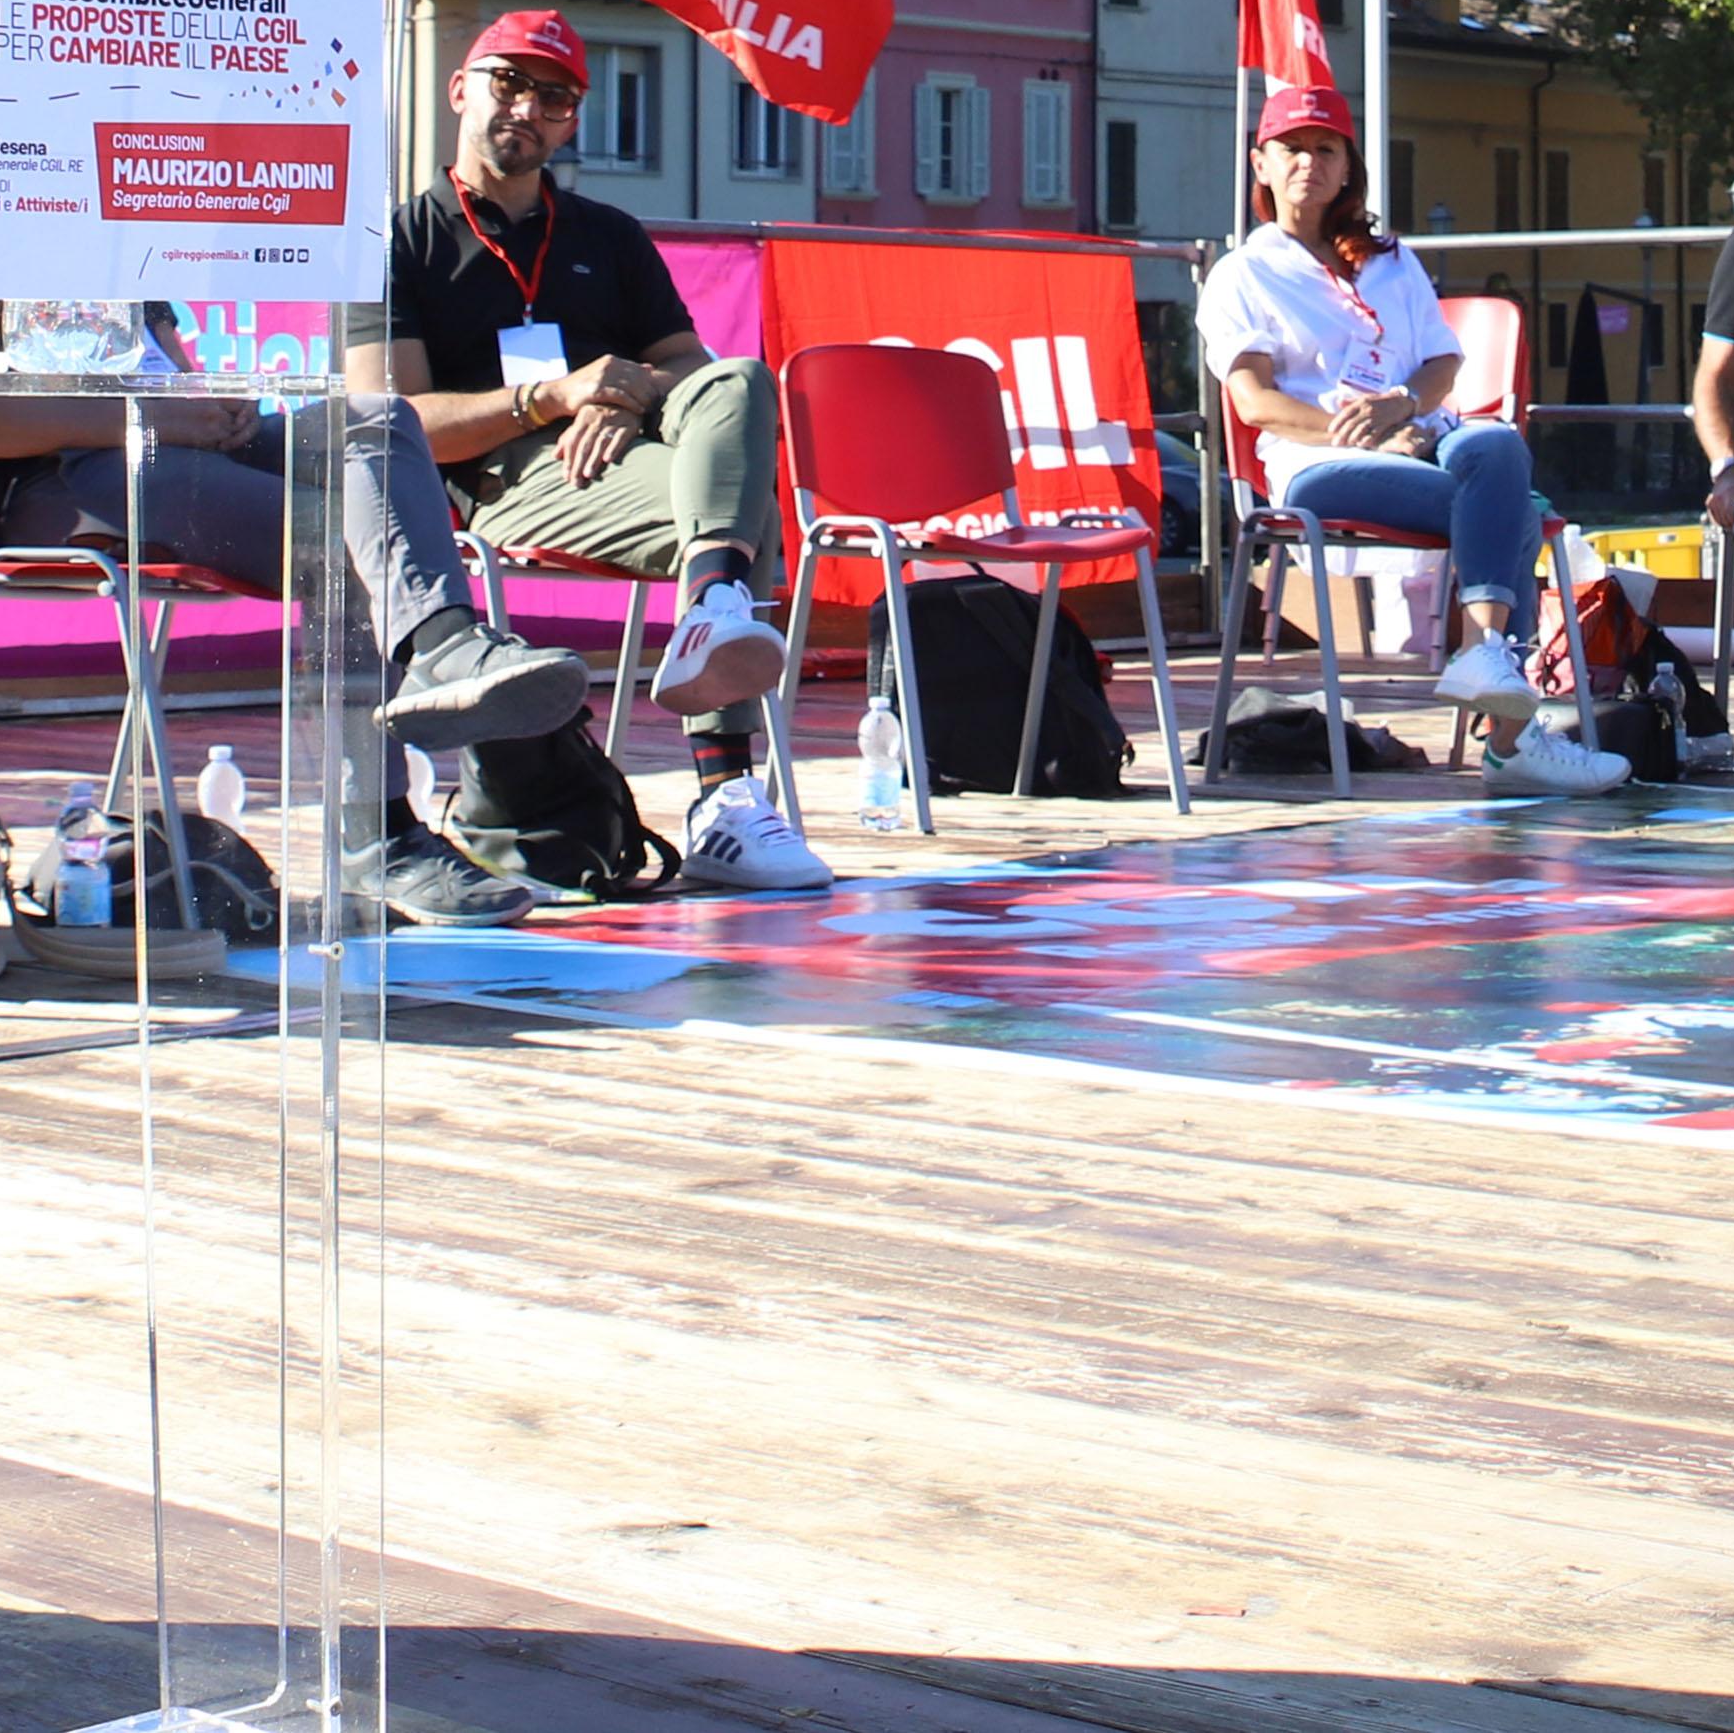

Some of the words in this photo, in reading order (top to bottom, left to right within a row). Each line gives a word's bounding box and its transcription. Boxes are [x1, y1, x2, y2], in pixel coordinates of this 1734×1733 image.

[32, 4, 165, 37] PROPOSTE
[172, 11, 249, 42] DELLA
[254, 17, 307, 45] CGIL
[49, 36, 180, 68] CAMBIARE
[186, 43, 206, 70] IL
[211, 44, 289, 73] PAESE
[112, 133, 205, 152] CONCLUSIONI
[40, 159, 66, 172] CGIL
[68, 160, 84, 172] RE
[112, 158, 233, 188] MAURIZIO
[237, 161, 334, 190] LANDINI
[0, 179, 10, 192] DI
[3, 200, 12, 211] e
[16, 197, 88, 213] Attiviste/i
[112, 189, 192, 211] Segretario
[194, 192, 260, 211] Generale
[262, 193, 291, 215] Cgil
[162, 249, 250, 262] cgilreggioemilia.it
